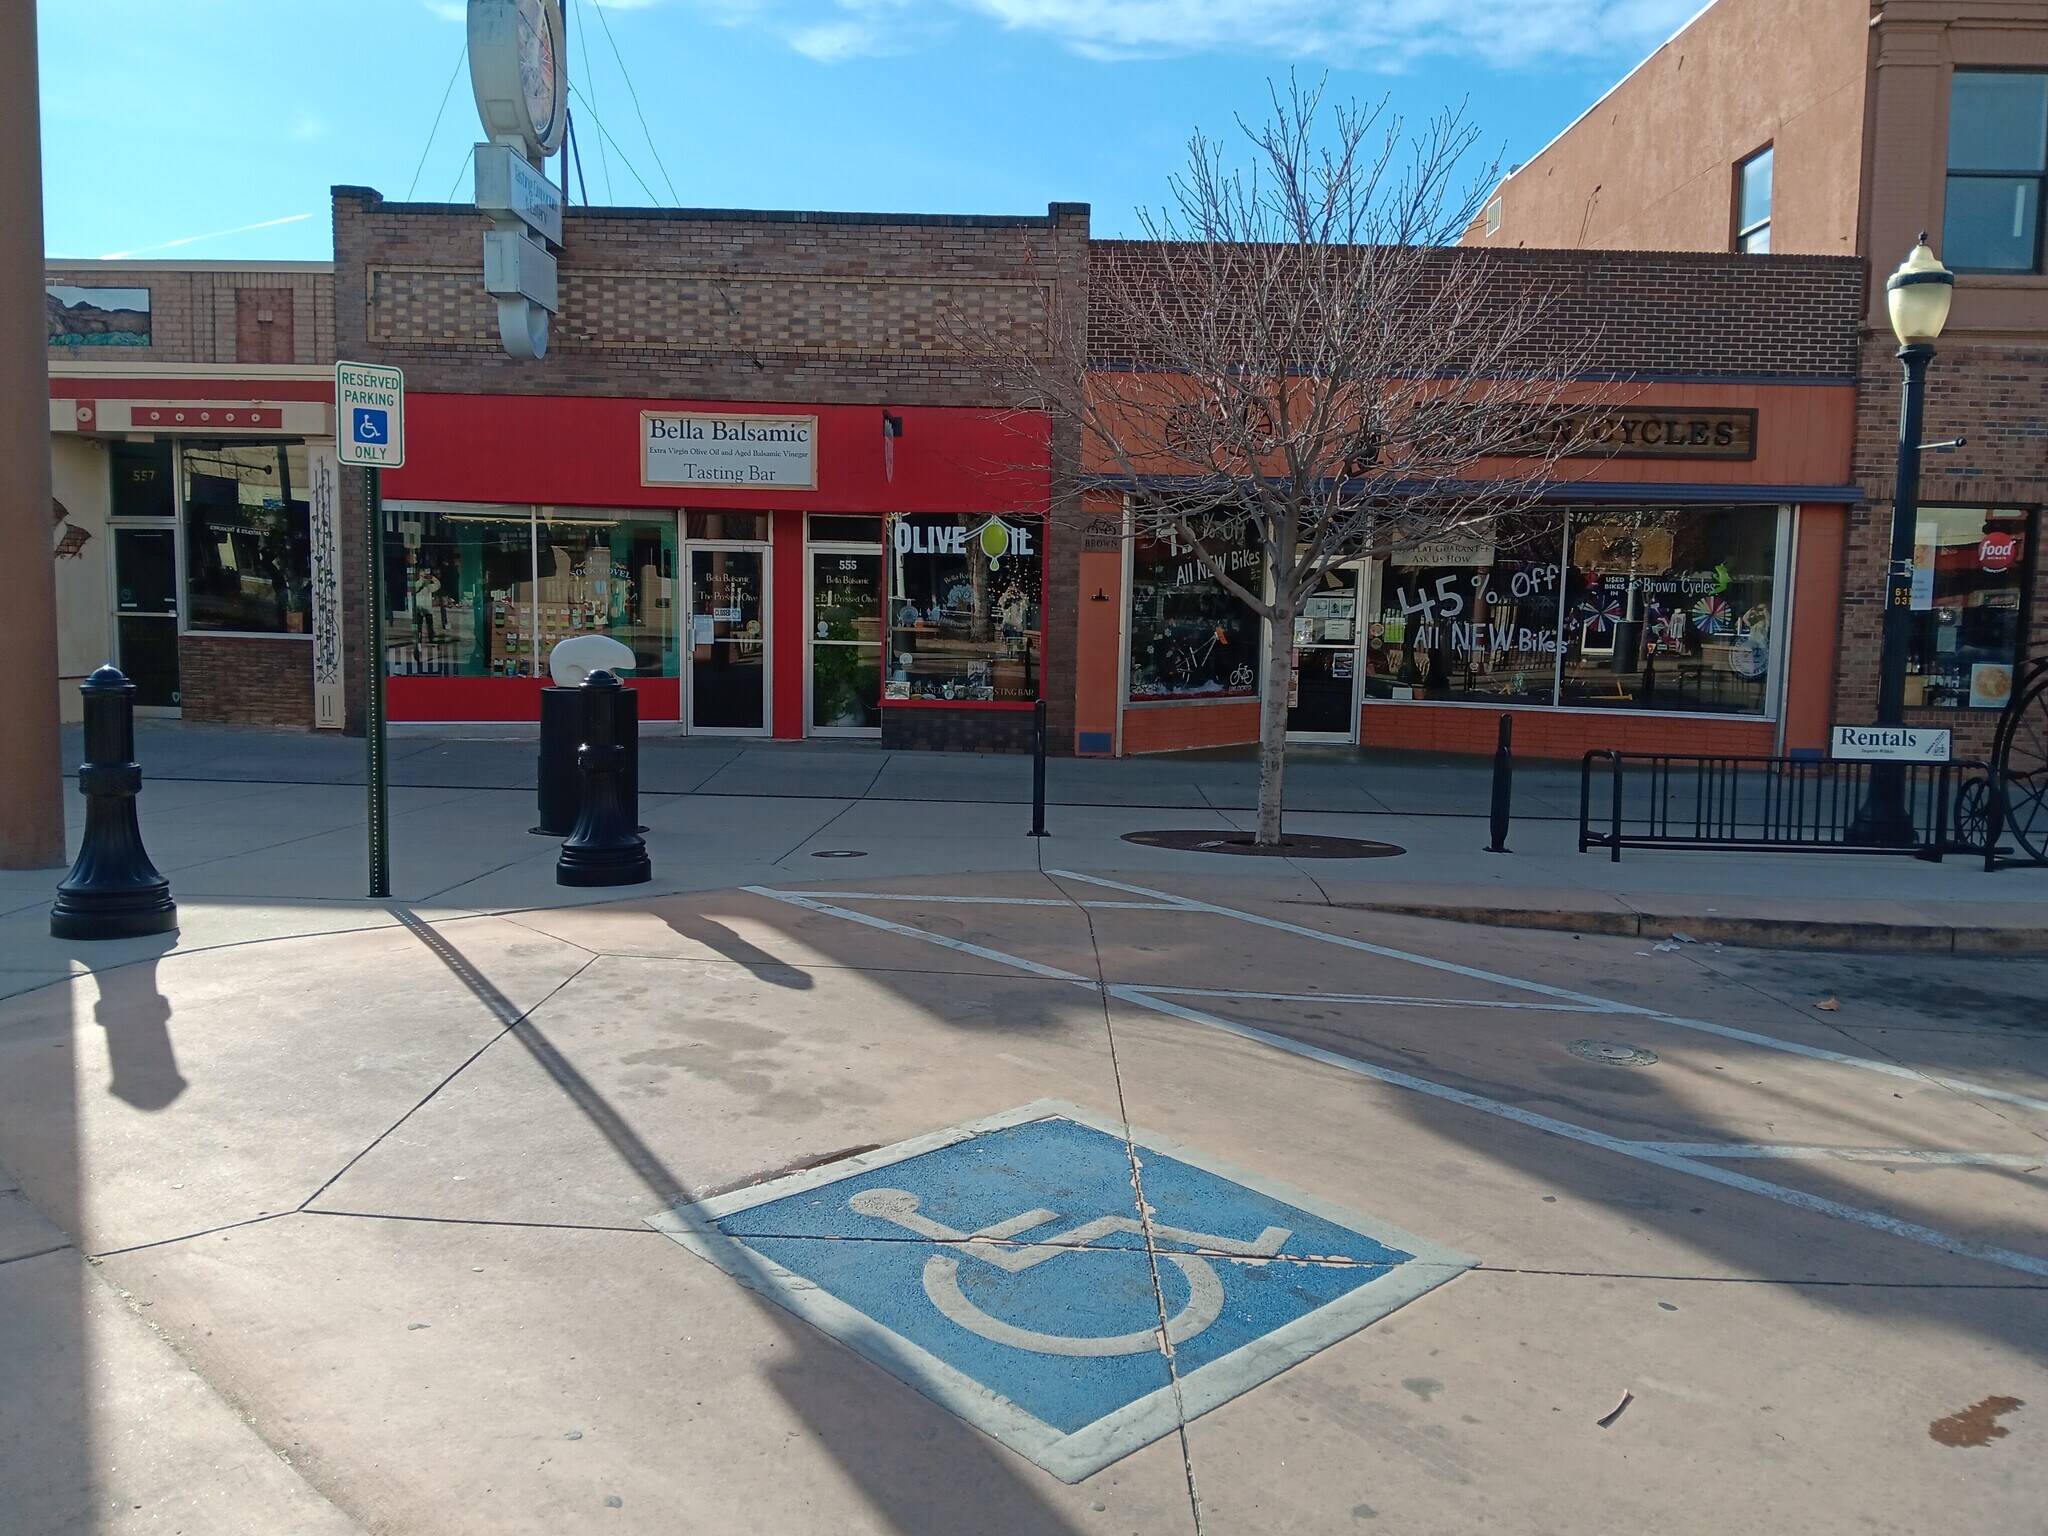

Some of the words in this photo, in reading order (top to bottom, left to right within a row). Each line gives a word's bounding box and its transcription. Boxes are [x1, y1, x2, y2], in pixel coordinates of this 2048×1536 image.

[514, 163, 533, 197] Tasting
[342, 372, 399, 390] RESERVED
[344, 390, 394, 406] PARKING
[650, 418, 704, 440] Bella
[711, 420, 809, 443] Balsamic
[1592, 419, 1735, 447] CYCLES
[355, 445, 387, 460] ONLY
[668, 447, 689, 456] Virgin
[708, 448, 720, 456] Oil
[734, 449, 751, 458] Aged
[752, 449, 781, 458] Balsamic
[782, 450, 809, 459] Vinegar
[133, 470, 156, 482] 557
[684, 463, 744, 484] Tasting
[749, 465, 776, 481] Bar
[894, 522, 967, 554] OLIVE
[1085, 539, 1118, 548] BROWN
[1980, 540, 2015, 561] food
[839, 560, 858, 571] 555
[1412, 555, 1429, 563] ASK
[1432, 555, 1444, 563] US
[569, 568, 595, 577] SOCK
[1176, 562, 1194, 587] All
[1231, 549, 1261, 571] Bikes
[705, 573, 722, 582] Bella
[722, 573, 750, 583] Balsamic
[826, 574, 841, 584] Bella
[842, 575, 870, 585] Balsamic
[1397, 574, 1464, 622] 45
[1471, 573, 1498, 604] %
[1511, 564, 1560, 597] Off
[1643, 577, 1677, 593] Brown
[1681, 577, 1716, 598] Cycles
[1895, 587, 1912, 597] 61
[834, 593, 860, 603] Pressed
[1894, 597, 1911, 606] 03
[1413, 626, 1440, 650] All
[1452, 621, 1515, 651] NEW
[1518, 628, 1568, 654] Bikes
[910, 686, 944, 695] PRESSED
[1018, 688, 1035, 697] BAR
[1840, 728, 1917, 747] Rentals
